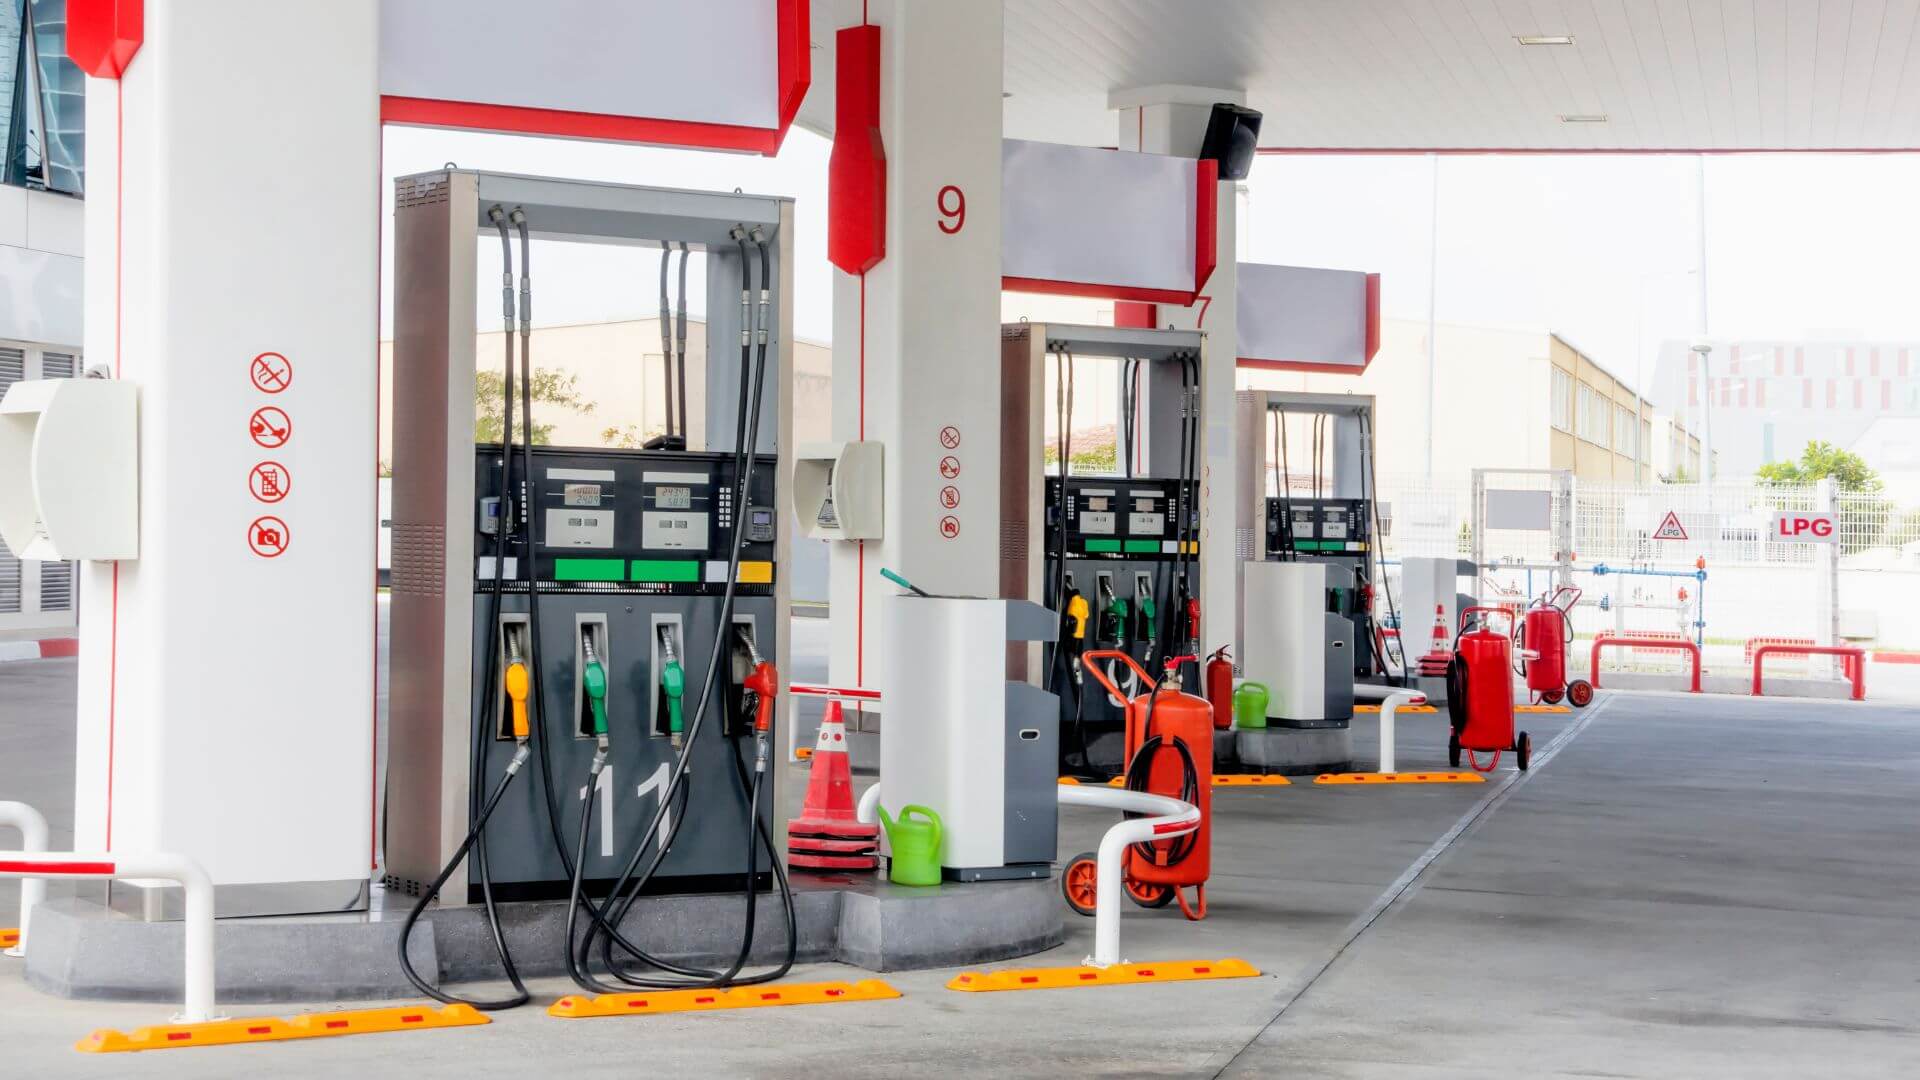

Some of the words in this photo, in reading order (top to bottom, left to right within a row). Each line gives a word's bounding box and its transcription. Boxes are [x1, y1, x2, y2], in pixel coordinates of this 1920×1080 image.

[937, 185, 966, 235] 9
[1197, 296, 1212, 329] 7
[1663, 528, 1680, 536] LPG
[1780, 518, 1832, 537] LPG
[1107, 657, 1138, 708] 9
[579, 762, 671, 857] 11
